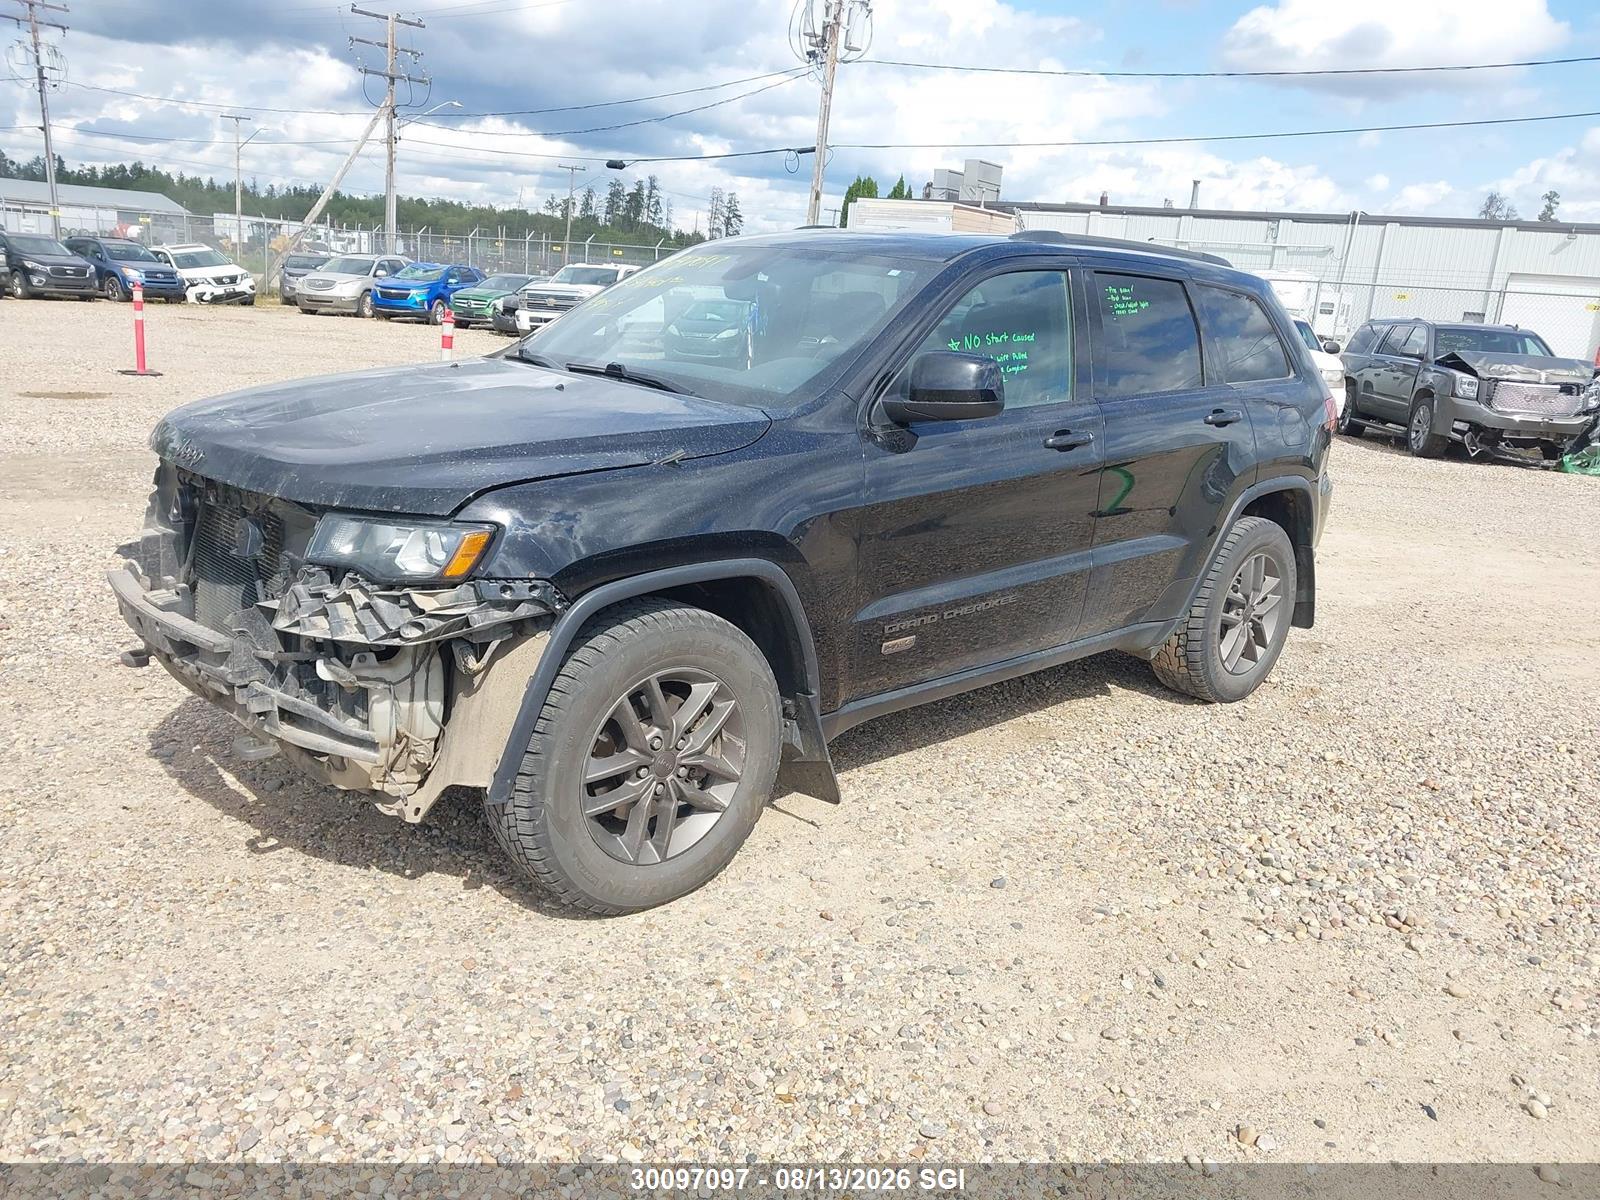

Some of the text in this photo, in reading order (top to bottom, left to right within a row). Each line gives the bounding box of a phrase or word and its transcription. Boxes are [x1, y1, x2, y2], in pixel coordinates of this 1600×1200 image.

[964, 333, 981, 350] NO
[884, 594, 1019, 634] GRAND CHEROKEE
